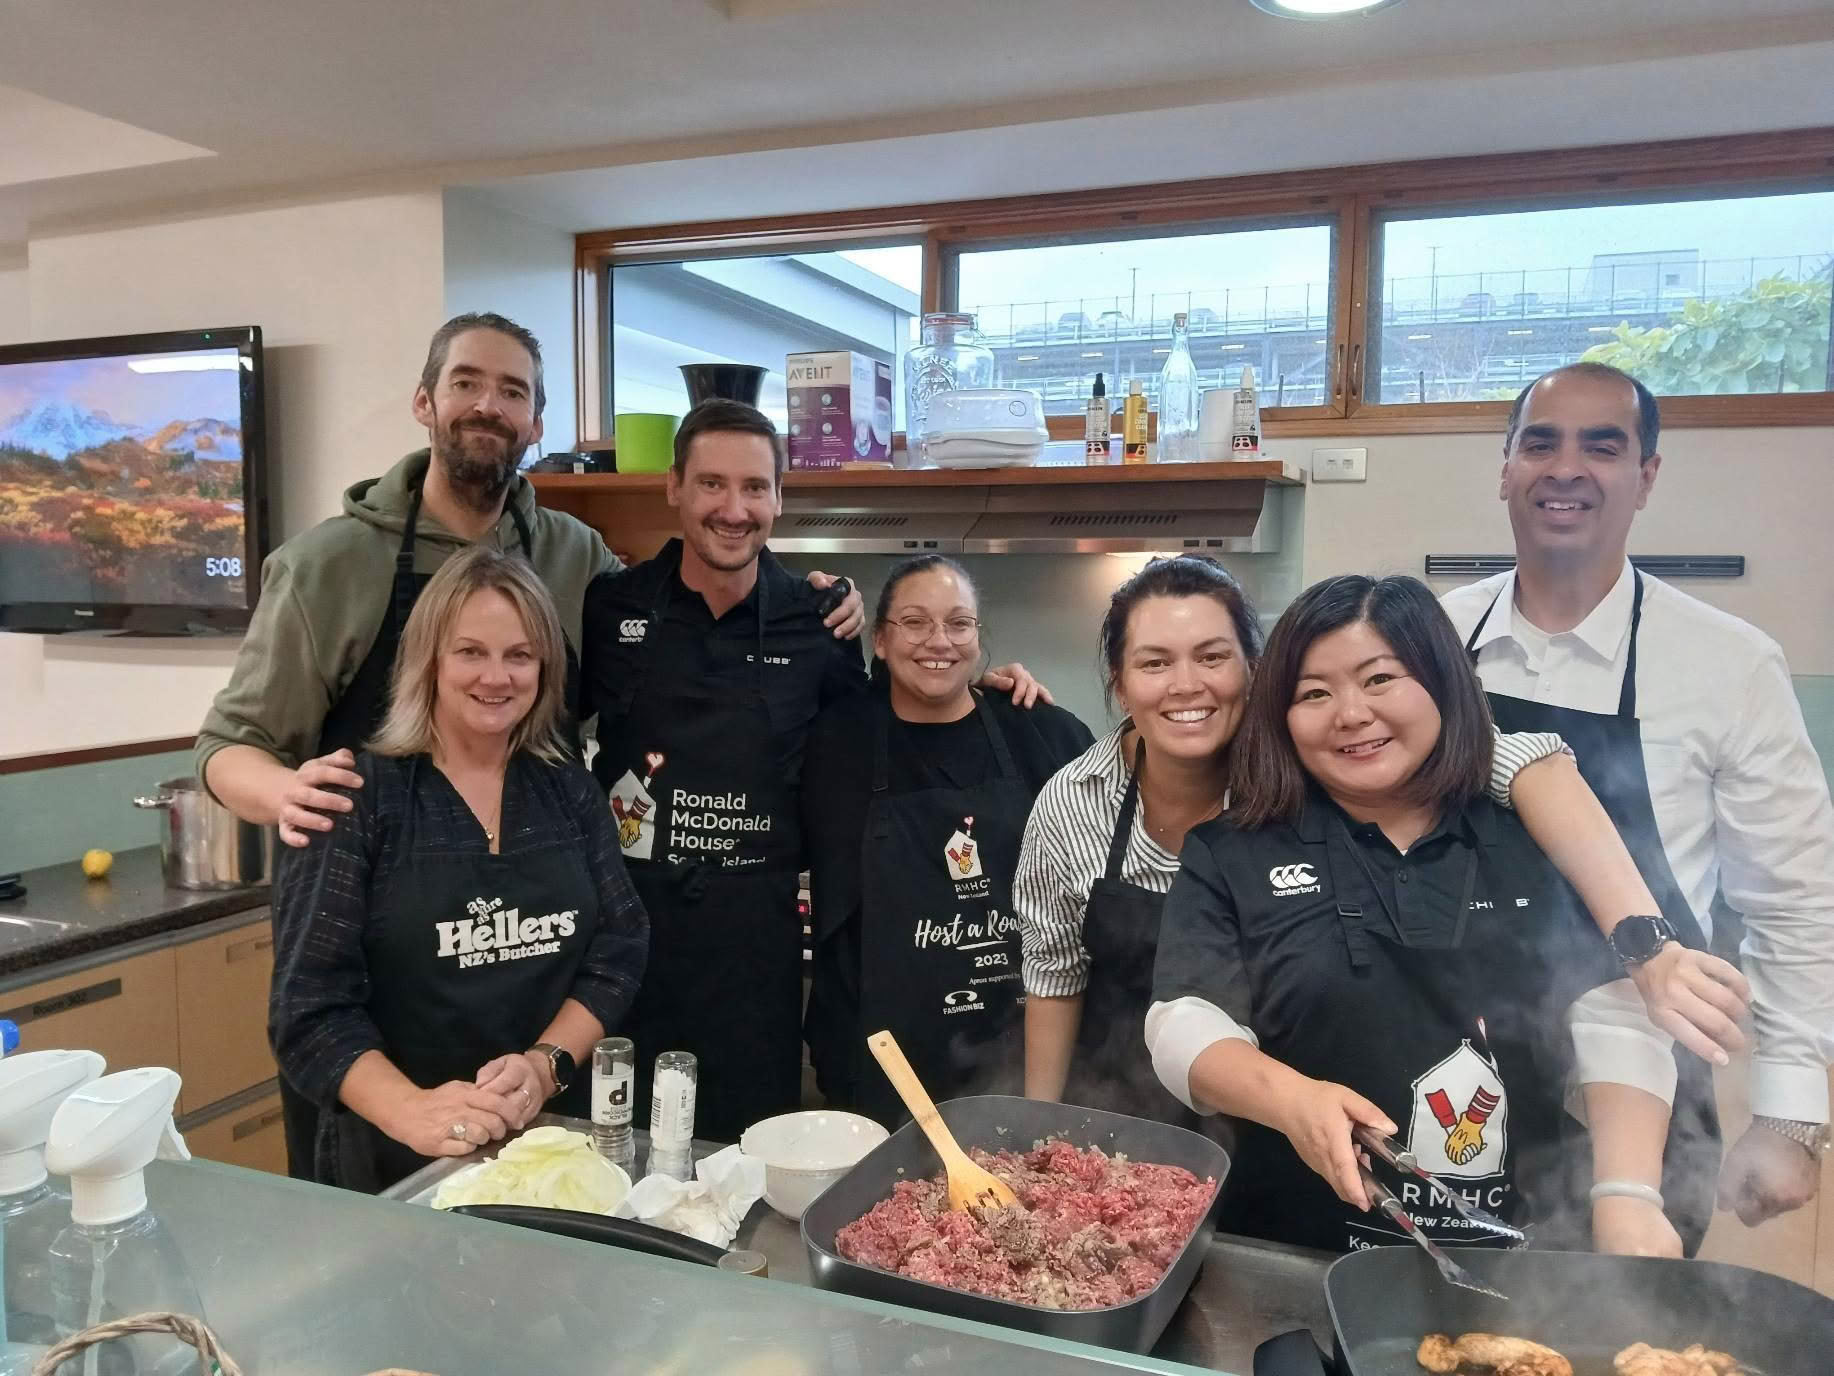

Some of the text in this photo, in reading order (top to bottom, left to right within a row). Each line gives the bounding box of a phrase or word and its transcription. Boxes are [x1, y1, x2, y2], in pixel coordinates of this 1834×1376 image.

[206, 557, 242, 577] 5:08
[747, 655, 790, 665] CUBB
[672, 789, 746, 810] Ronald
[671, 809, 771, 832] McDonald
[670, 830, 735, 851] House
[1273, 885, 1321, 896] canterbury
[466, 897, 486, 914] as
[435, 908, 576, 957] Hellers
[914, 909, 1021, 949] Host a Roa
[458, 941, 561, 969] NZ's Butcher
[974, 953, 1009, 967] 2023
